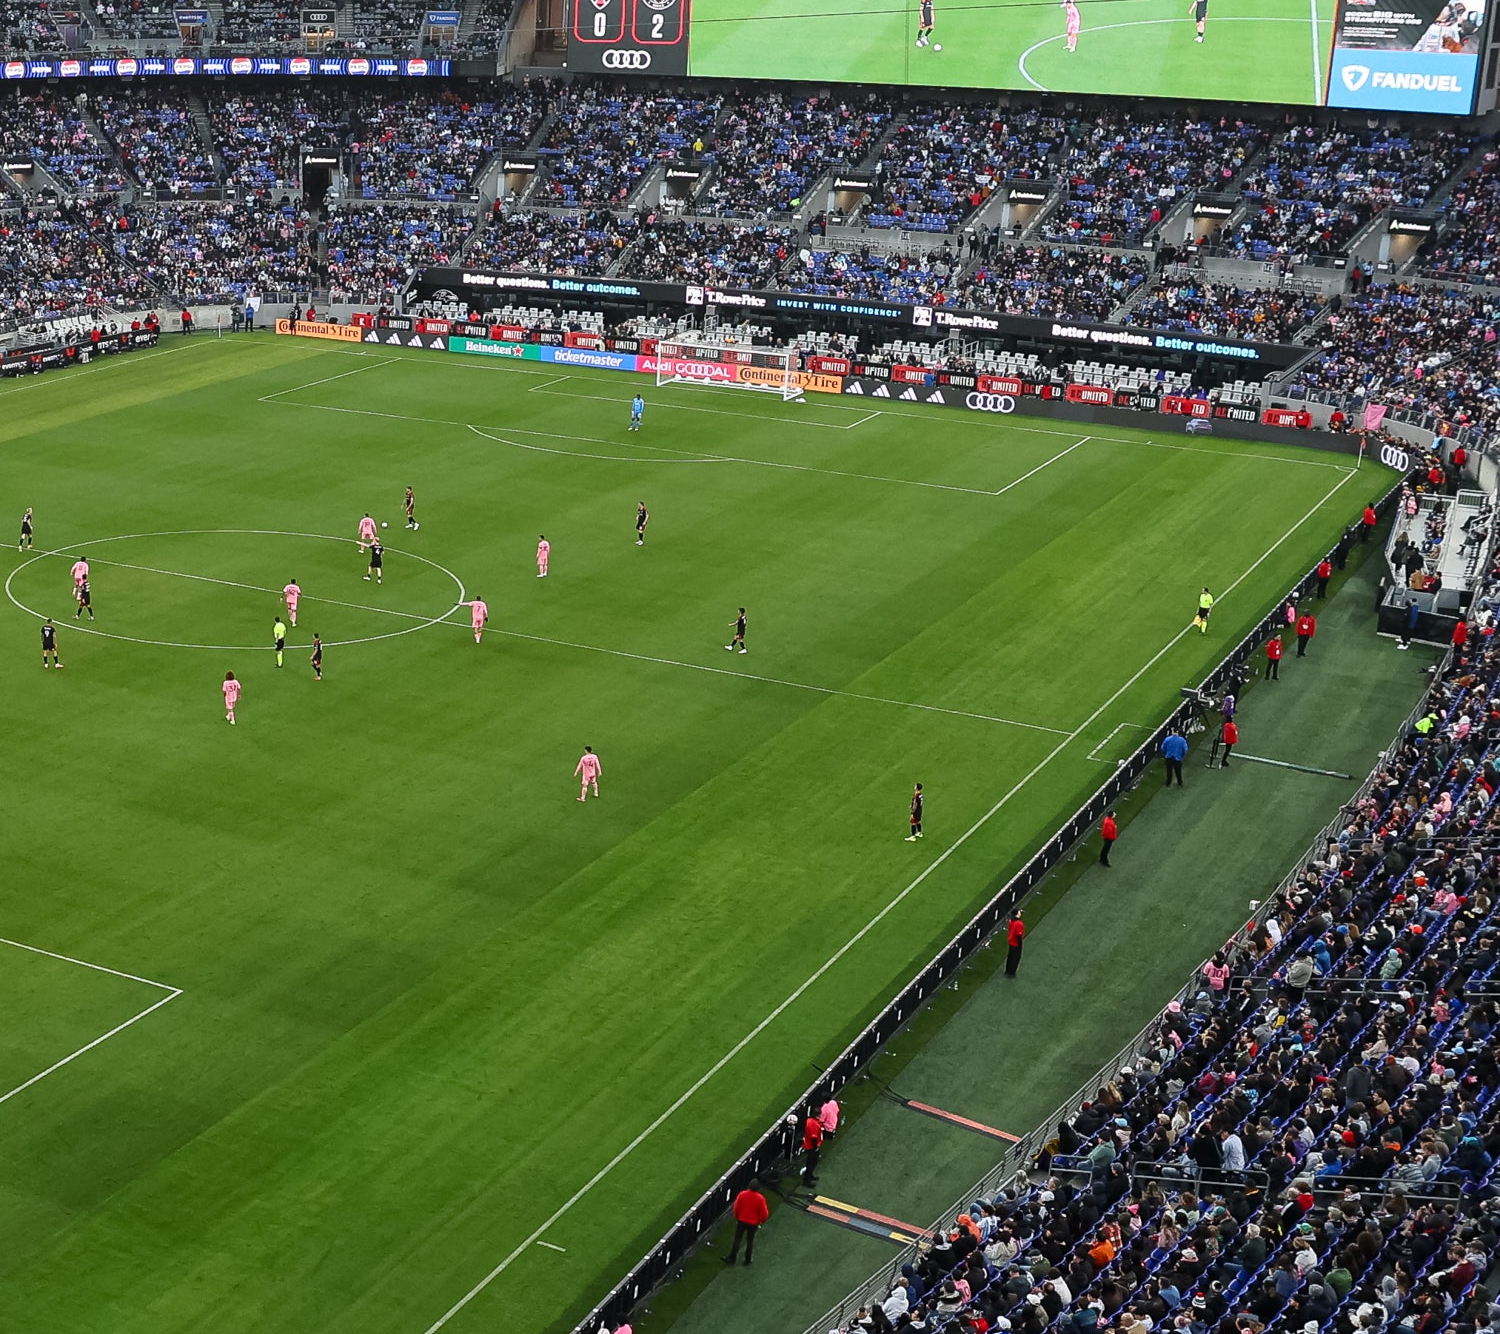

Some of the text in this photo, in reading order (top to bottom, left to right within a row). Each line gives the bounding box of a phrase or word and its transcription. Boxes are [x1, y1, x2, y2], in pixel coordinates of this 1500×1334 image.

[594, 12, 664, 39] 0 2
[1371, 72, 1462, 93] FANDUEL
[463, 273, 641, 296] Better questions. Better outcomes.
[776, 299, 809, 309] INVEST
[813, 302, 837, 311] WITH
[338, 326, 359, 339] Tire
[466, 340, 512, 355] Heineken
[1052, 324, 1260, 359] Better questions. Better outcomes.
[554, 350, 623, 367] ticketmaster
[814, 375, 839, 389] Tire
